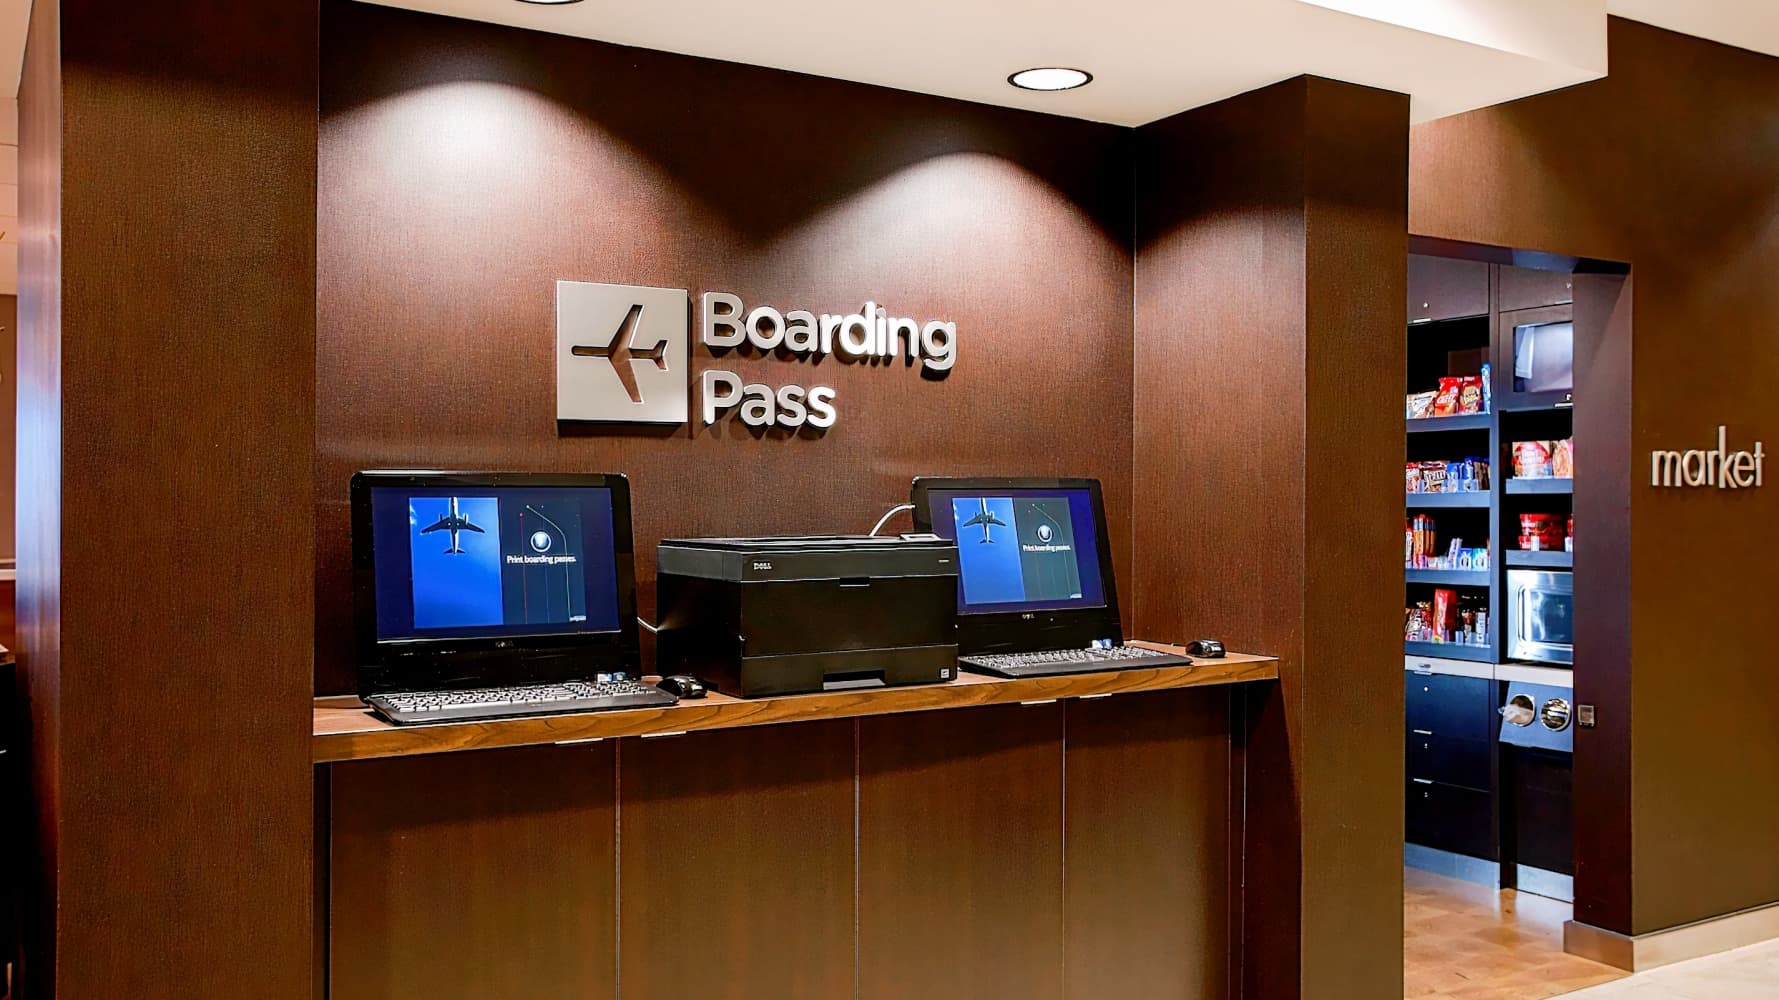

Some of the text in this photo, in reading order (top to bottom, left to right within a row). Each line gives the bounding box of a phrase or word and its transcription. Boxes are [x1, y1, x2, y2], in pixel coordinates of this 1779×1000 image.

[703, 291, 957, 371] Boarding
[702, 370, 837, 429] Pass
[1651, 425, 1765, 489] market
[506, 555, 523, 564] Print
[524, 555, 553, 564] boarding
